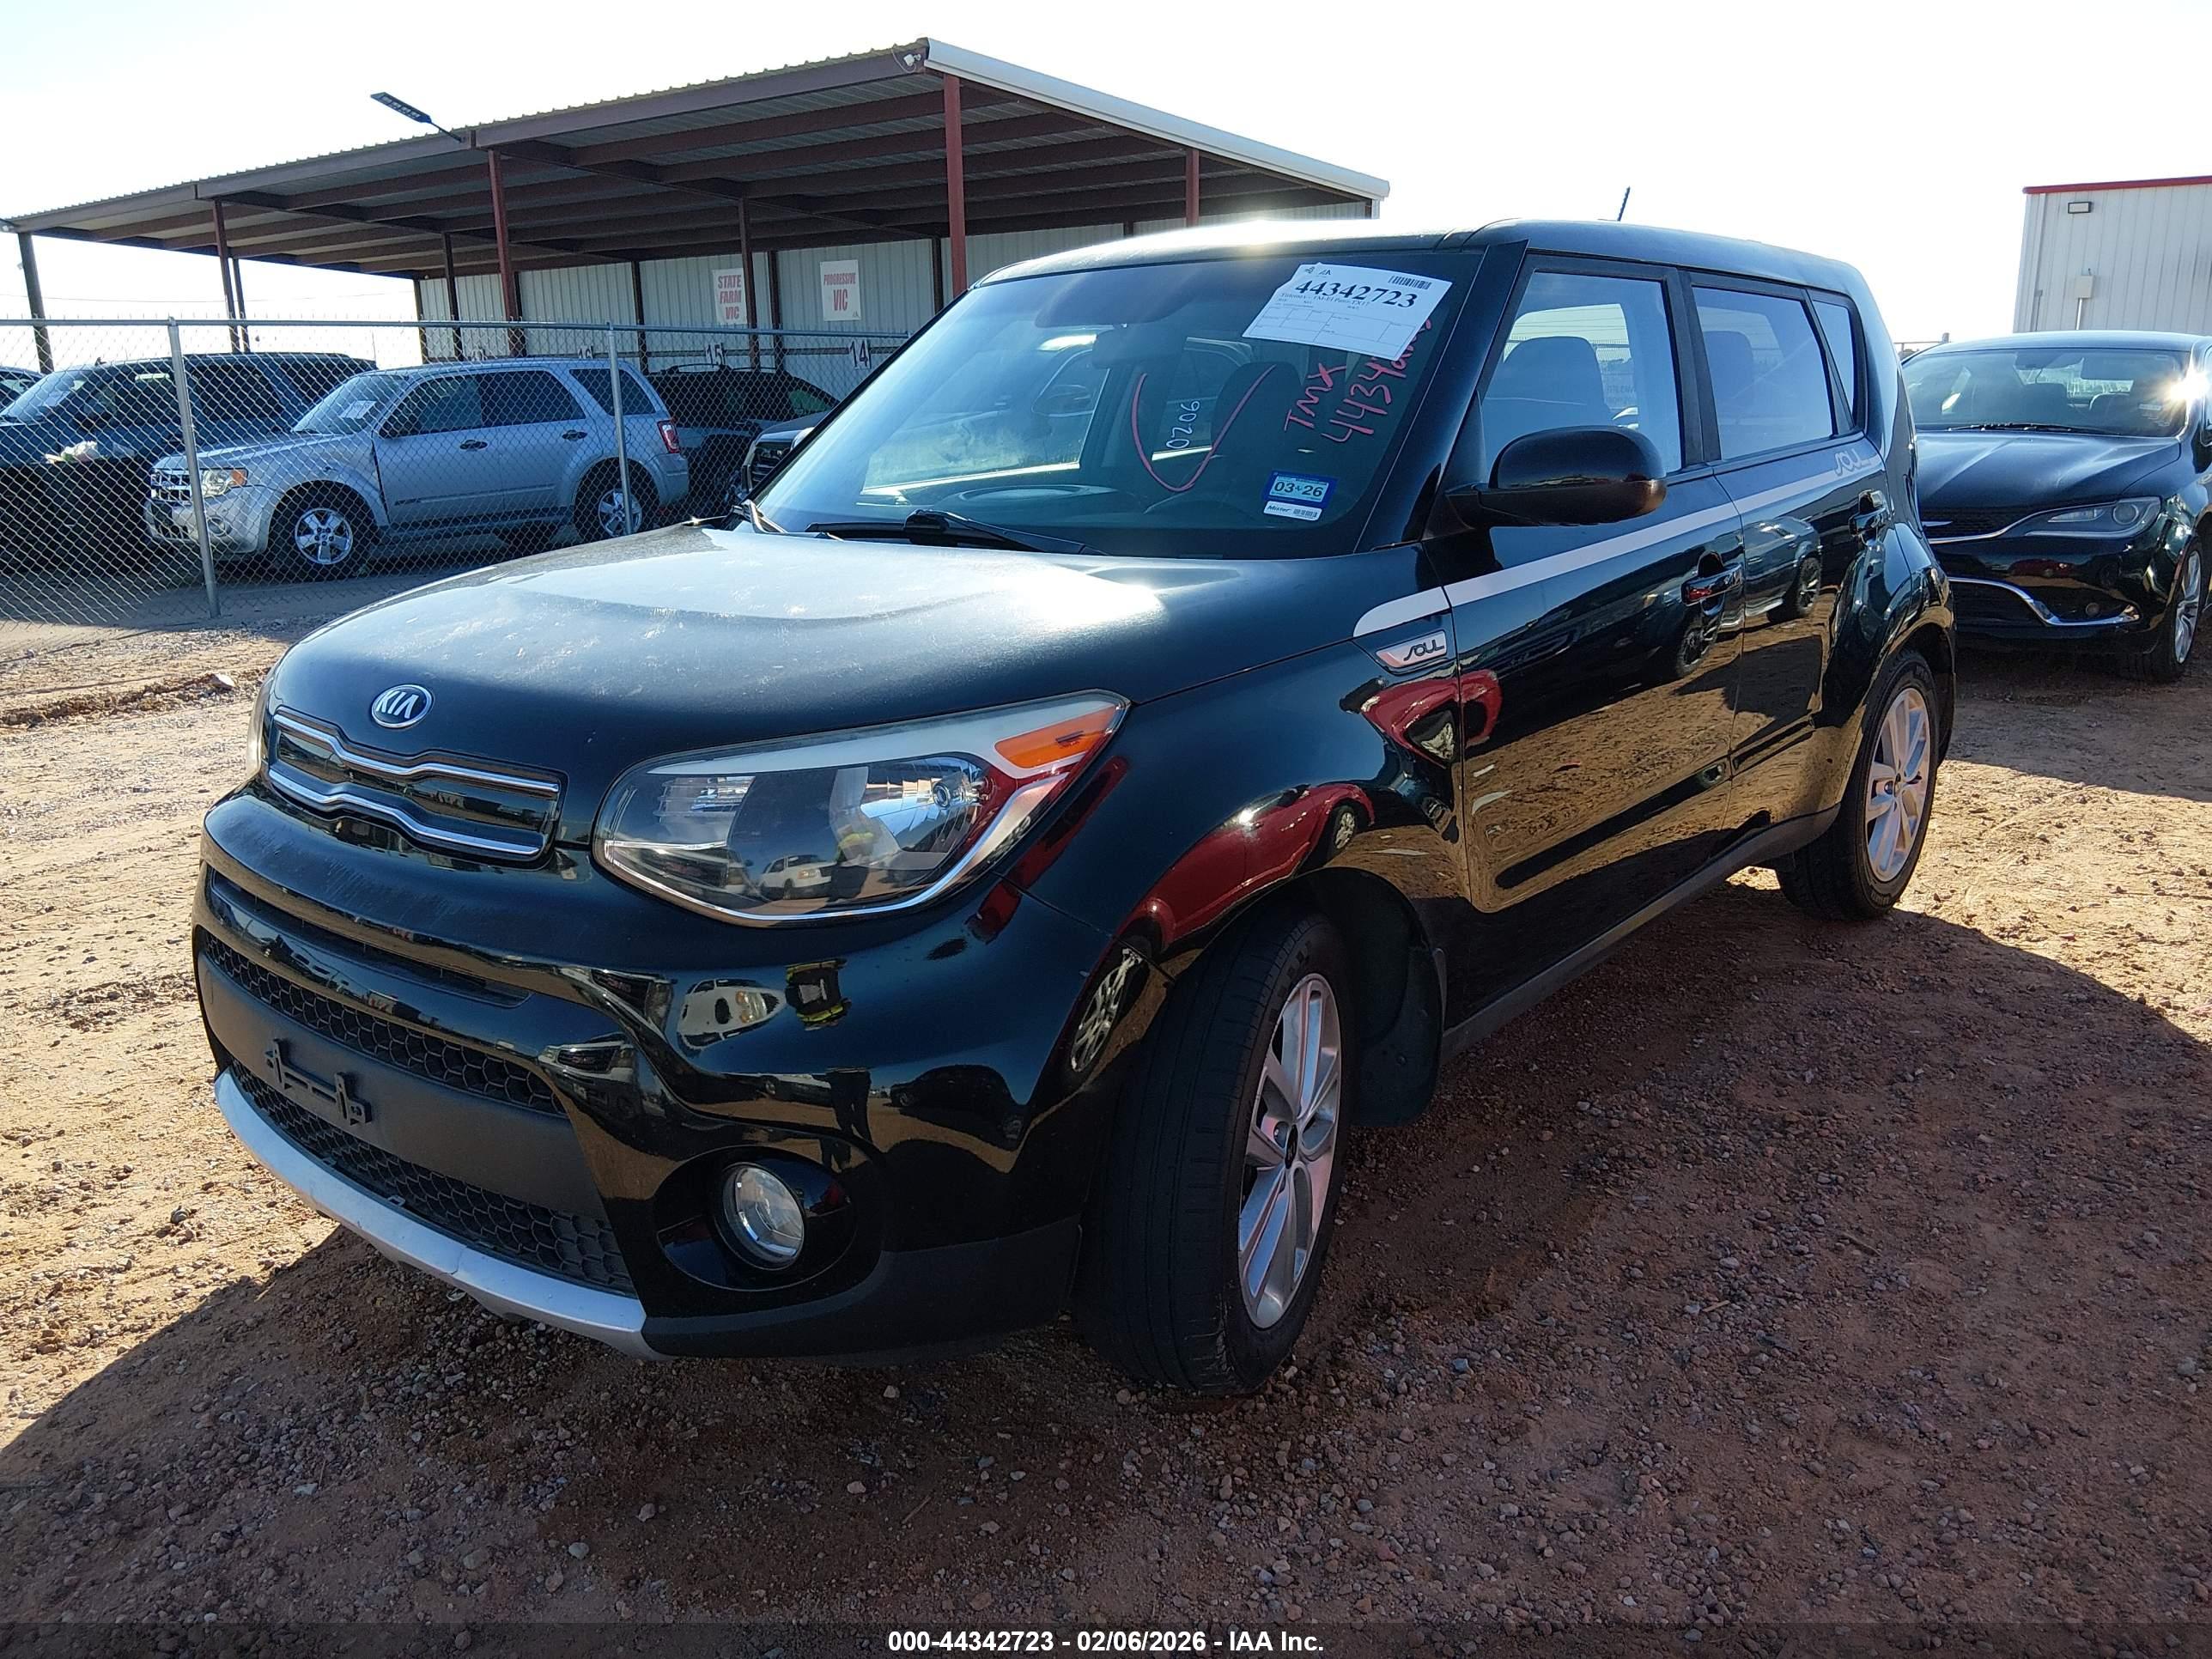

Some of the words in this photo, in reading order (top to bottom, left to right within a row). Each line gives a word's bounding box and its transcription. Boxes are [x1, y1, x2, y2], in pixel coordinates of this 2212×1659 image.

[718, 274, 742, 289] STATE
[720, 290, 742, 304] FARM
[834, 289, 848, 311] VIC
[1295, 280, 1418, 308] 44342723
[726, 306, 740, 319] VIC
[849, 340, 869, 368] 14
[1274, 481, 1295, 493] 03
[1301, 485, 1324, 497] 26
[1402, 639, 1445, 661] SOUL
[375, 690, 420, 720] KIA
